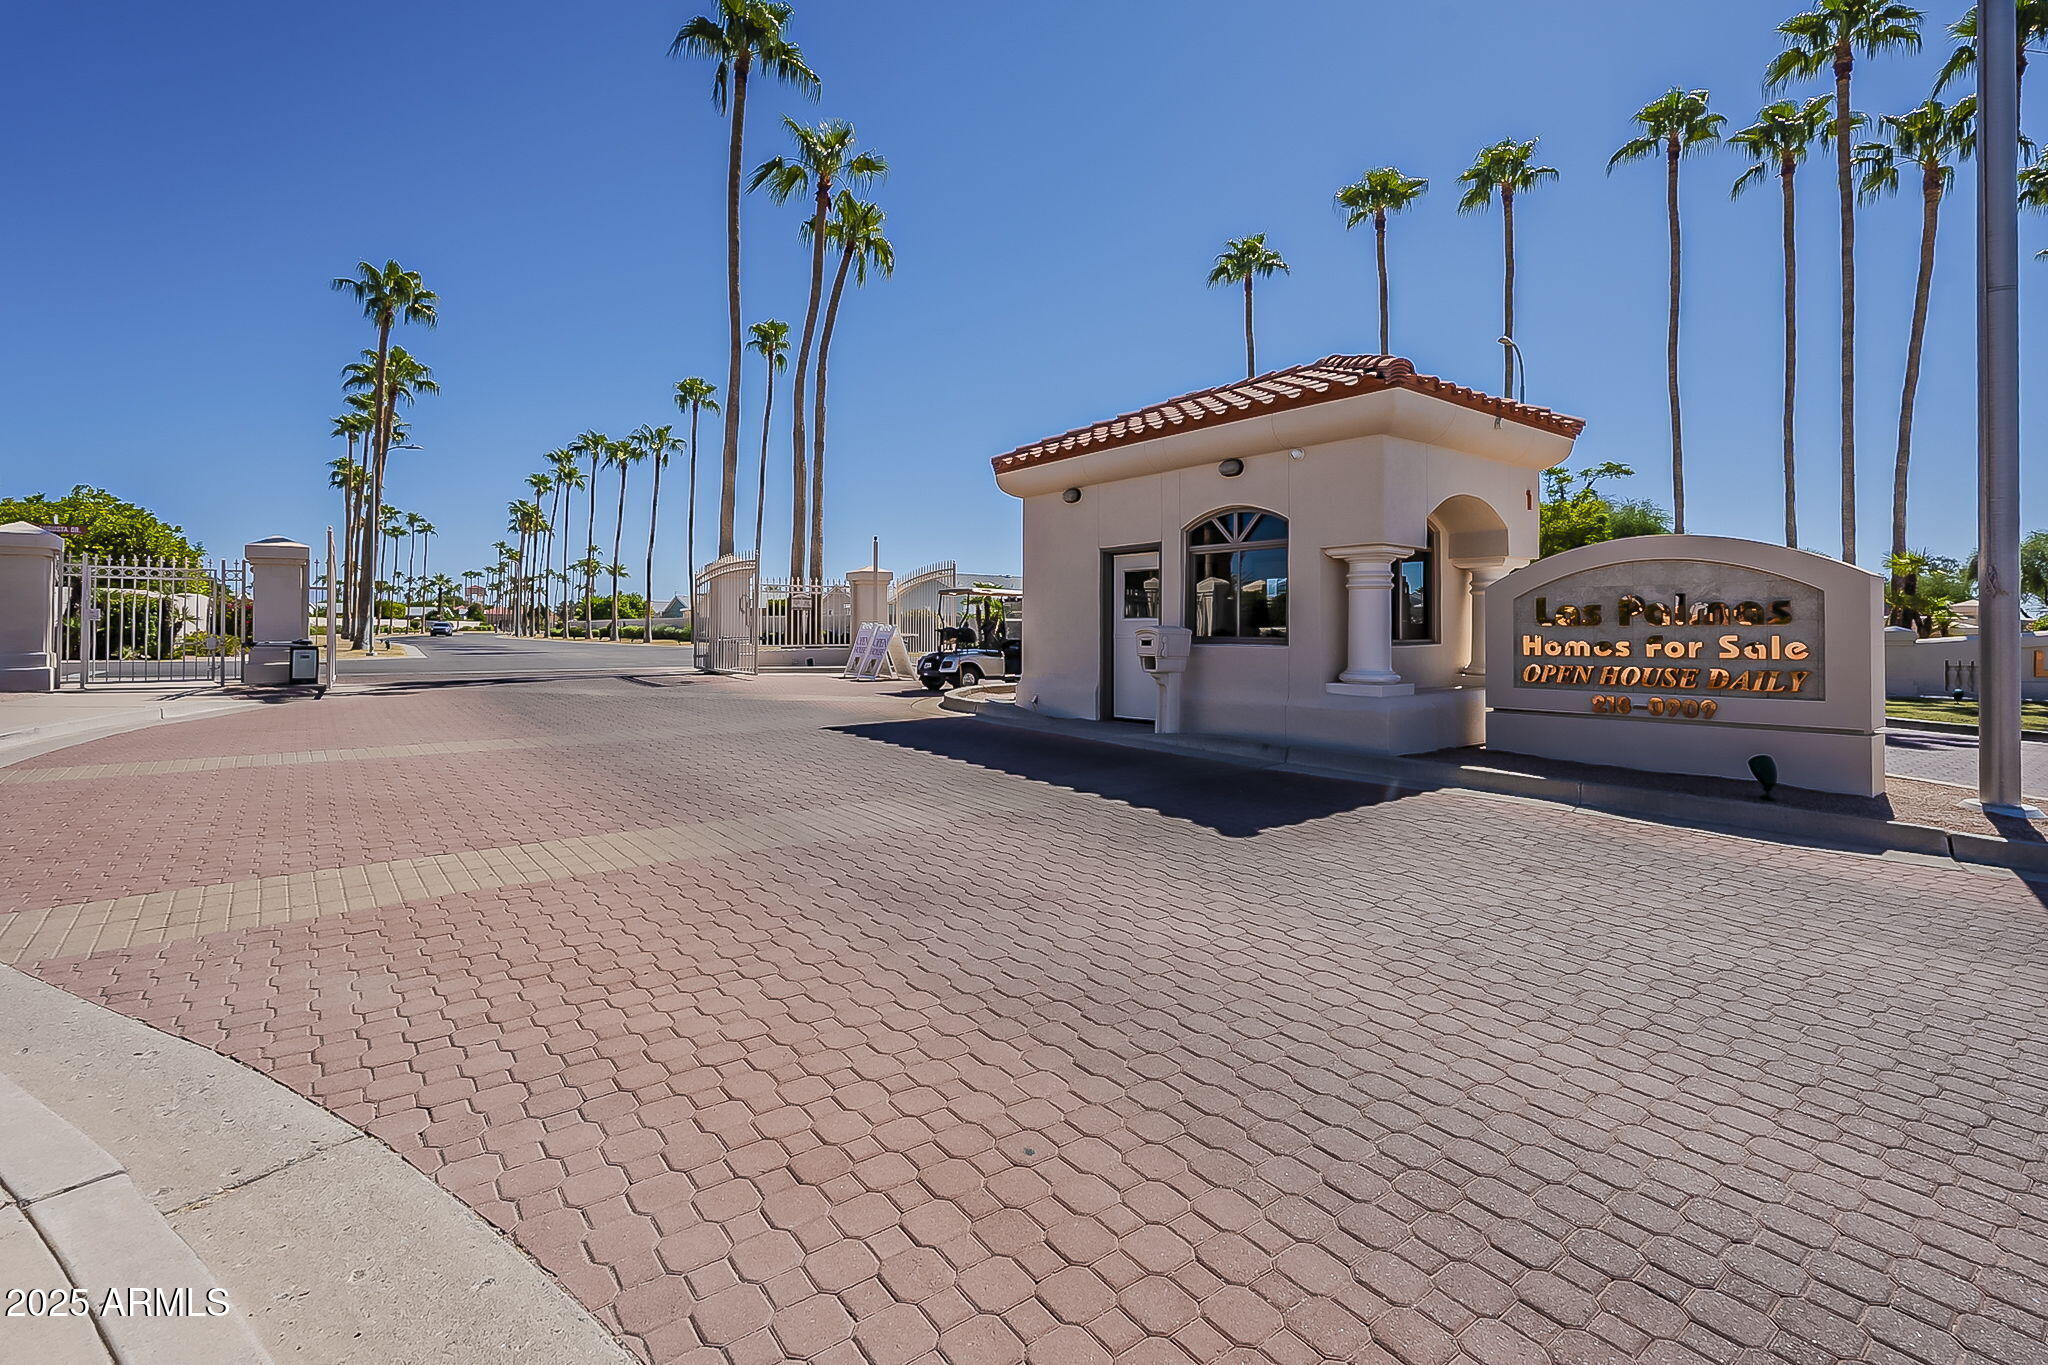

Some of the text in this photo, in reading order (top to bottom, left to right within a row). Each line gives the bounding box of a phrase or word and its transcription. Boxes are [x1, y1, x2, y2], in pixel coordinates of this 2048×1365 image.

[1535, 593, 1793, 627] Las Palmas
[1522, 634, 1810, 660] Homes for Sale
[1522, 663, 1811, 693] OPEN HOUSE DAILY
